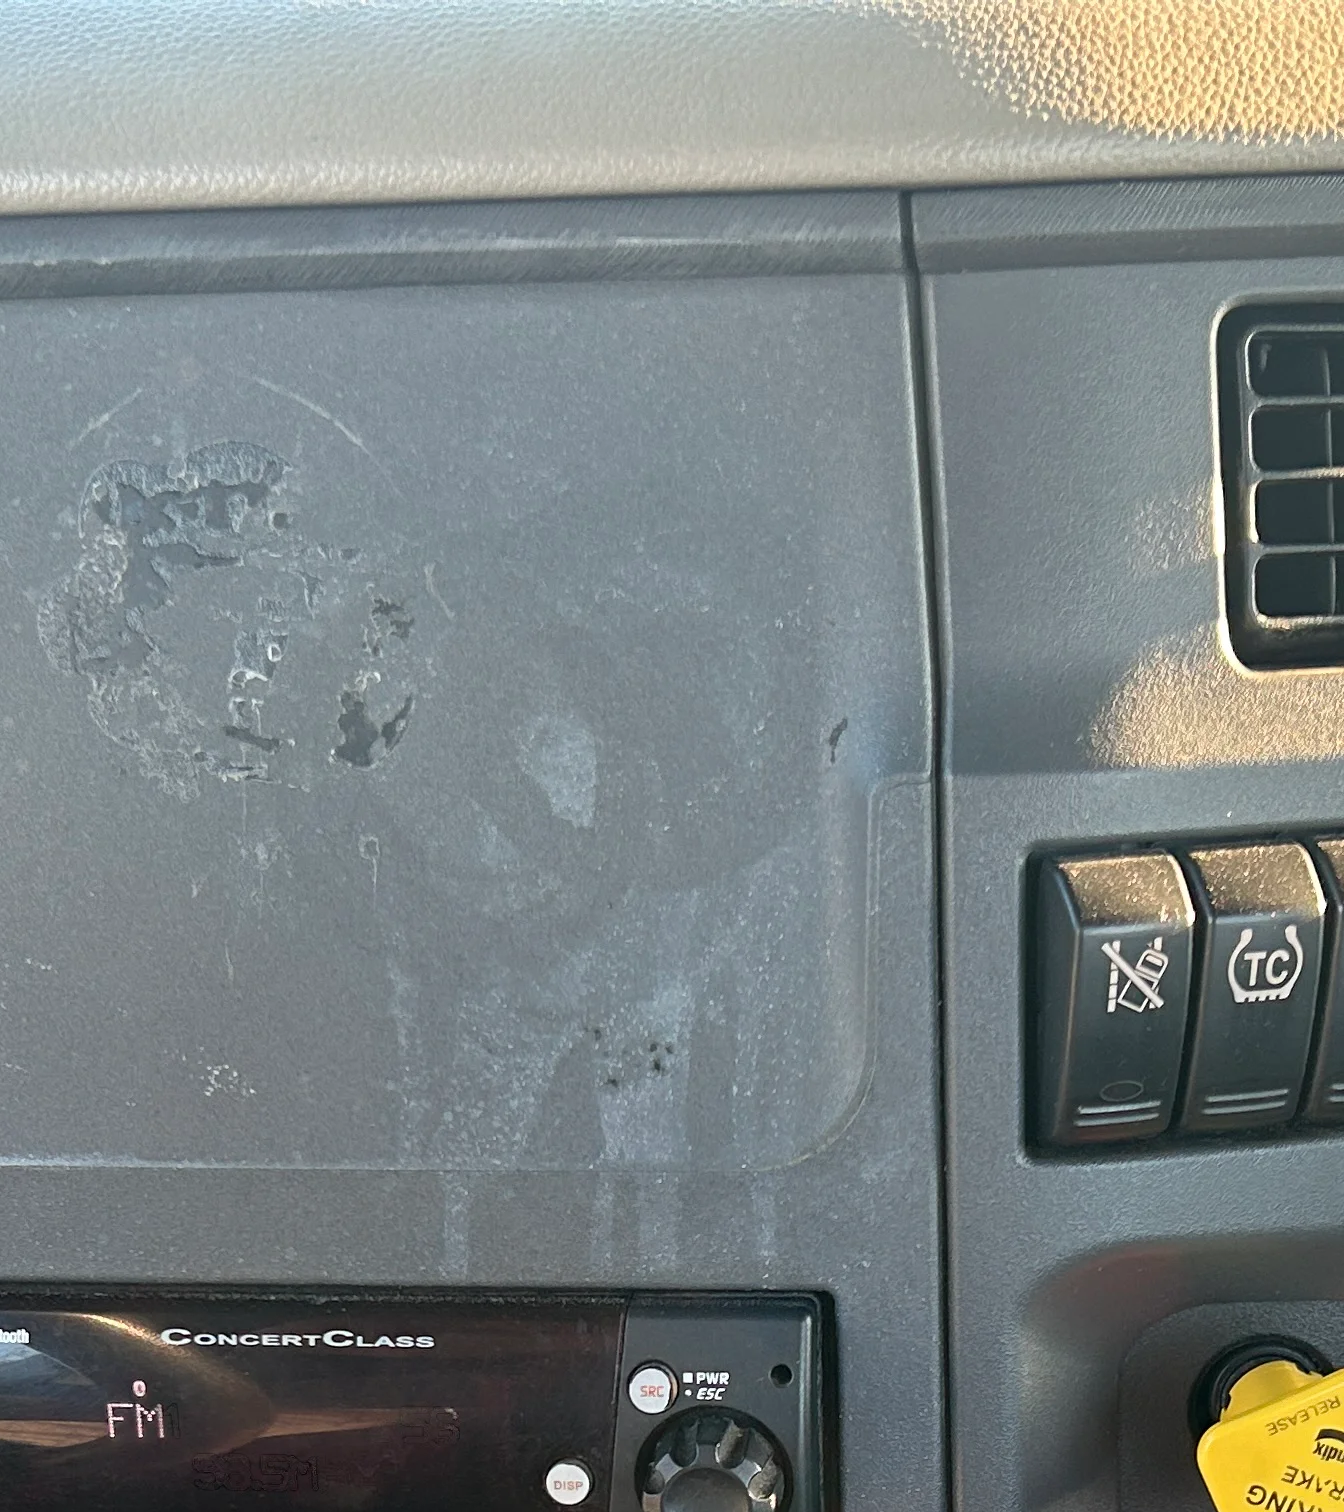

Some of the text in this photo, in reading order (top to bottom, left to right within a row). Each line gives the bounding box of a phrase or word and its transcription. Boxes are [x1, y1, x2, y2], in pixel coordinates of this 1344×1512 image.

[1243, 950, 1290, 987] TC
[695, 1372, 730, 1386] PWR
[640, 1385, 665, 1397] SRC
[696, 1387, 726, 1401] ESC
[1265, 1395, 1341, 1436] RELEASE
[553, 1480, 584, 1491] DISP
